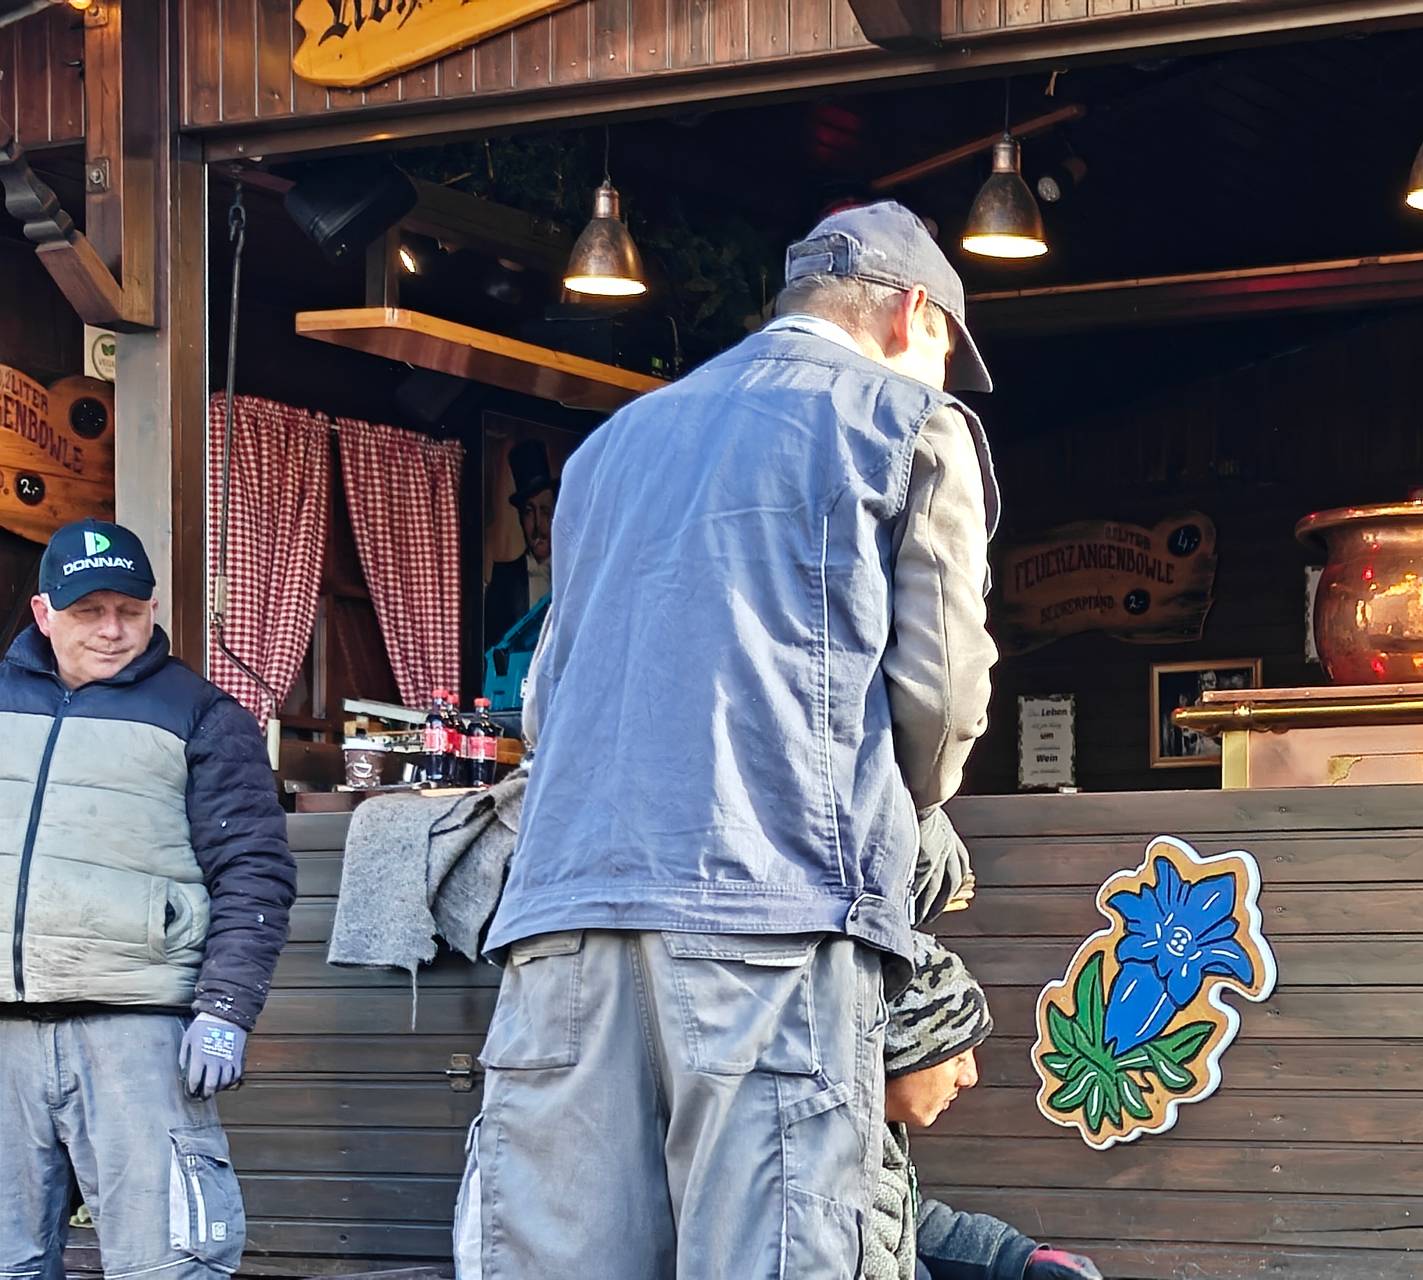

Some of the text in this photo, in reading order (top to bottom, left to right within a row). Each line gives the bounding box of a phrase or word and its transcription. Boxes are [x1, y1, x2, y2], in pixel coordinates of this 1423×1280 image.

[0, 393, 84, 474] ENBOWLE
[1015, 543, 1175, 592] FEUERZANGENBOWLE
[1041, 708, 1068, 717] Leben
[1036, 754, 1058, 763] Wein
